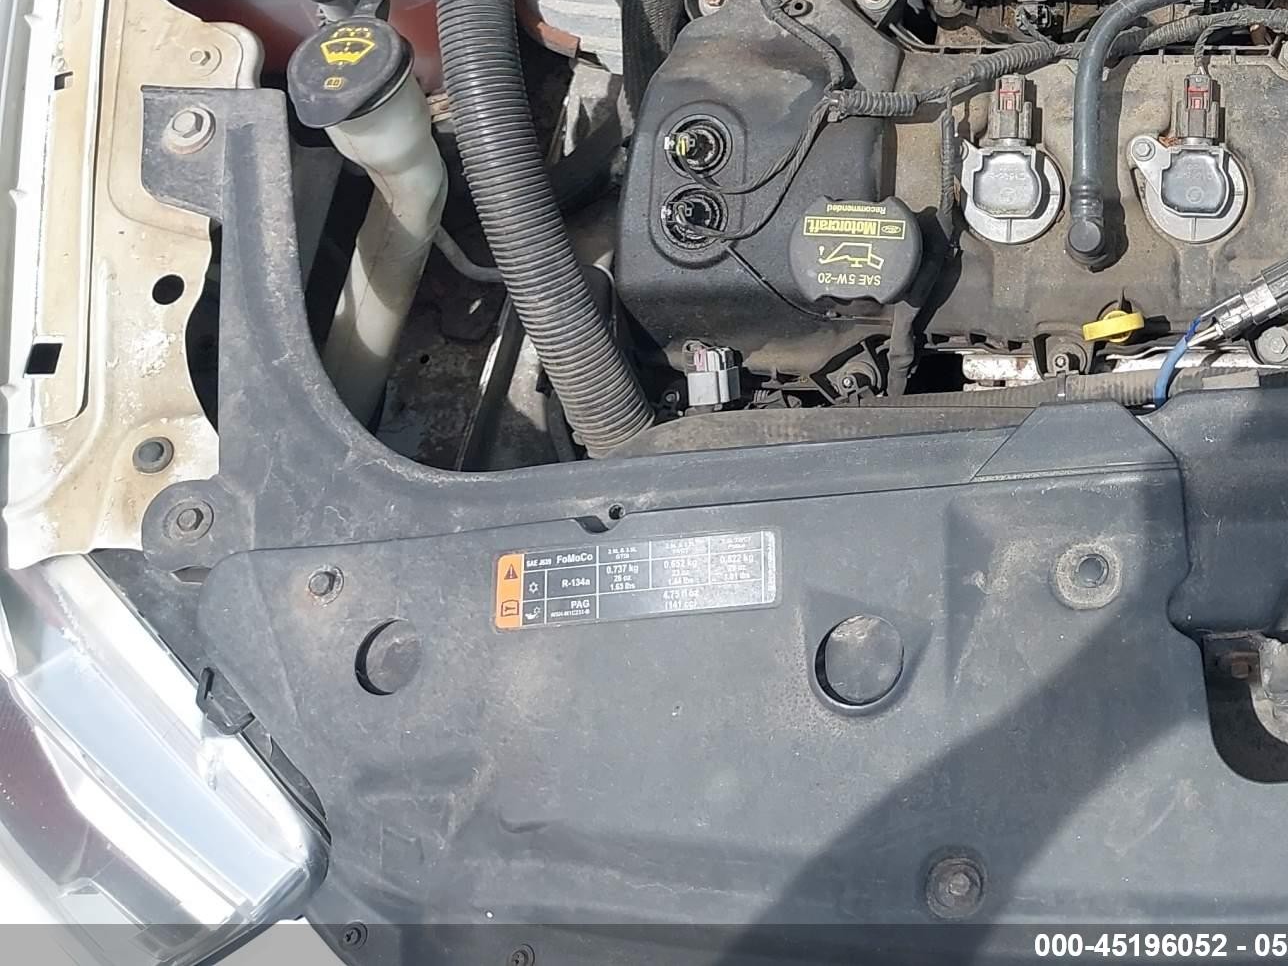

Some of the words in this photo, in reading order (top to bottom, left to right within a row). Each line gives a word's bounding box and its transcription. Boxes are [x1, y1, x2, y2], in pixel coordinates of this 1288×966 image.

[826, 204, 887, 215] Recommended
[808, 219, 877, 235] Motorcraft
[817, 273, 856, 284] 5W-20
[858, 274, 882, 285] SAE
[556, 552, 594, 564] FoMoCo
[687, 559, 698, 568] kg
[742, 554, 754, 563] kg
[606, 565, 628, 574] 0.737
[629, 565, 639, 574] kg
[562, 577, 591, 588] R-134a
[570, 599, 590, 610] PAG
